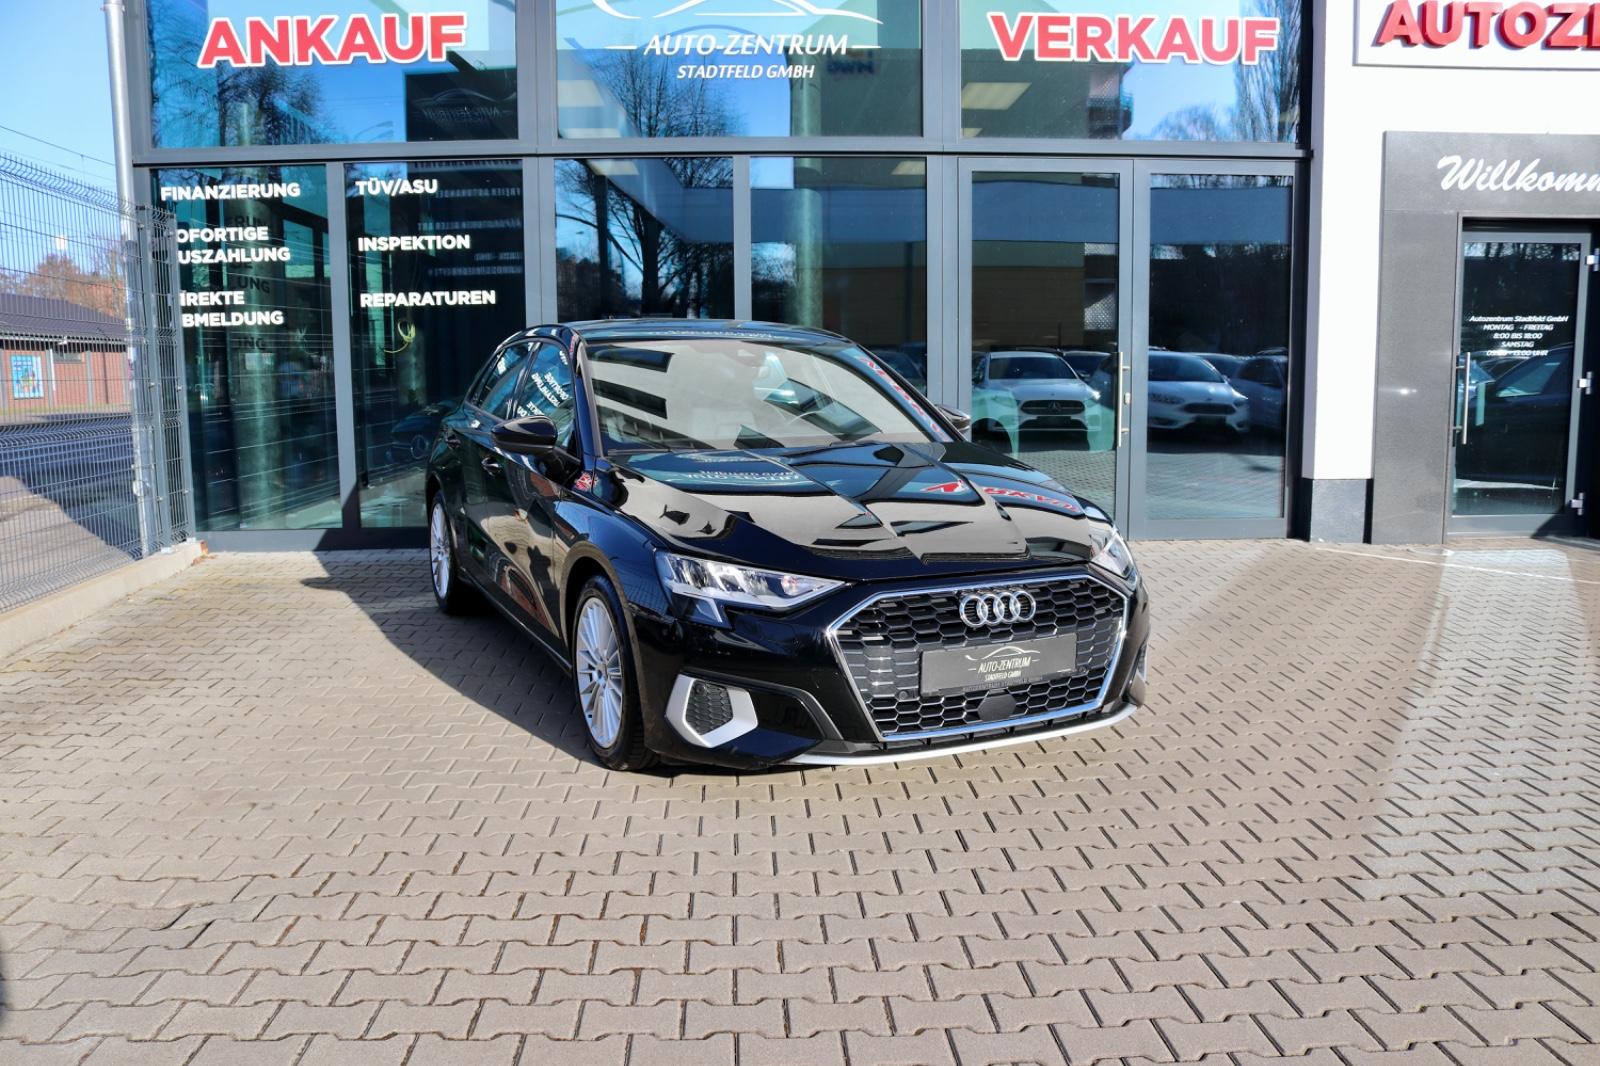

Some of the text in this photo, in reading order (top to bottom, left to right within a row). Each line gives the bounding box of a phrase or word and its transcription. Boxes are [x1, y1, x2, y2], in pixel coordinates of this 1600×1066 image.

[197, 13, 466, 67] ANKAUF
[643, 33, 849, 56] AUTO-ZENTRUM
[987, 12, 1280, 65] VERKAUF
[677, 64, 763, 79] STADTFELD
[766, 64, 815, 79] GMBH
[160, 182, 301, 201] FINANZIERUNG
[355, 177, 439, 197] TÜV/ASU
[176, 226, 270, 244] OFORTIGE
[357, 234, 471, 252] INSPEKTION
[178, 246, 291, 265] USZAHLUNG
[180, 290, 245, 307] IREKTE
[359, 289, 497, 308] REPARATUREN
[181, 310, 285, 328] BMELDUNG
[978, 656, 1031, 674] AUTO-ZENTRUM
